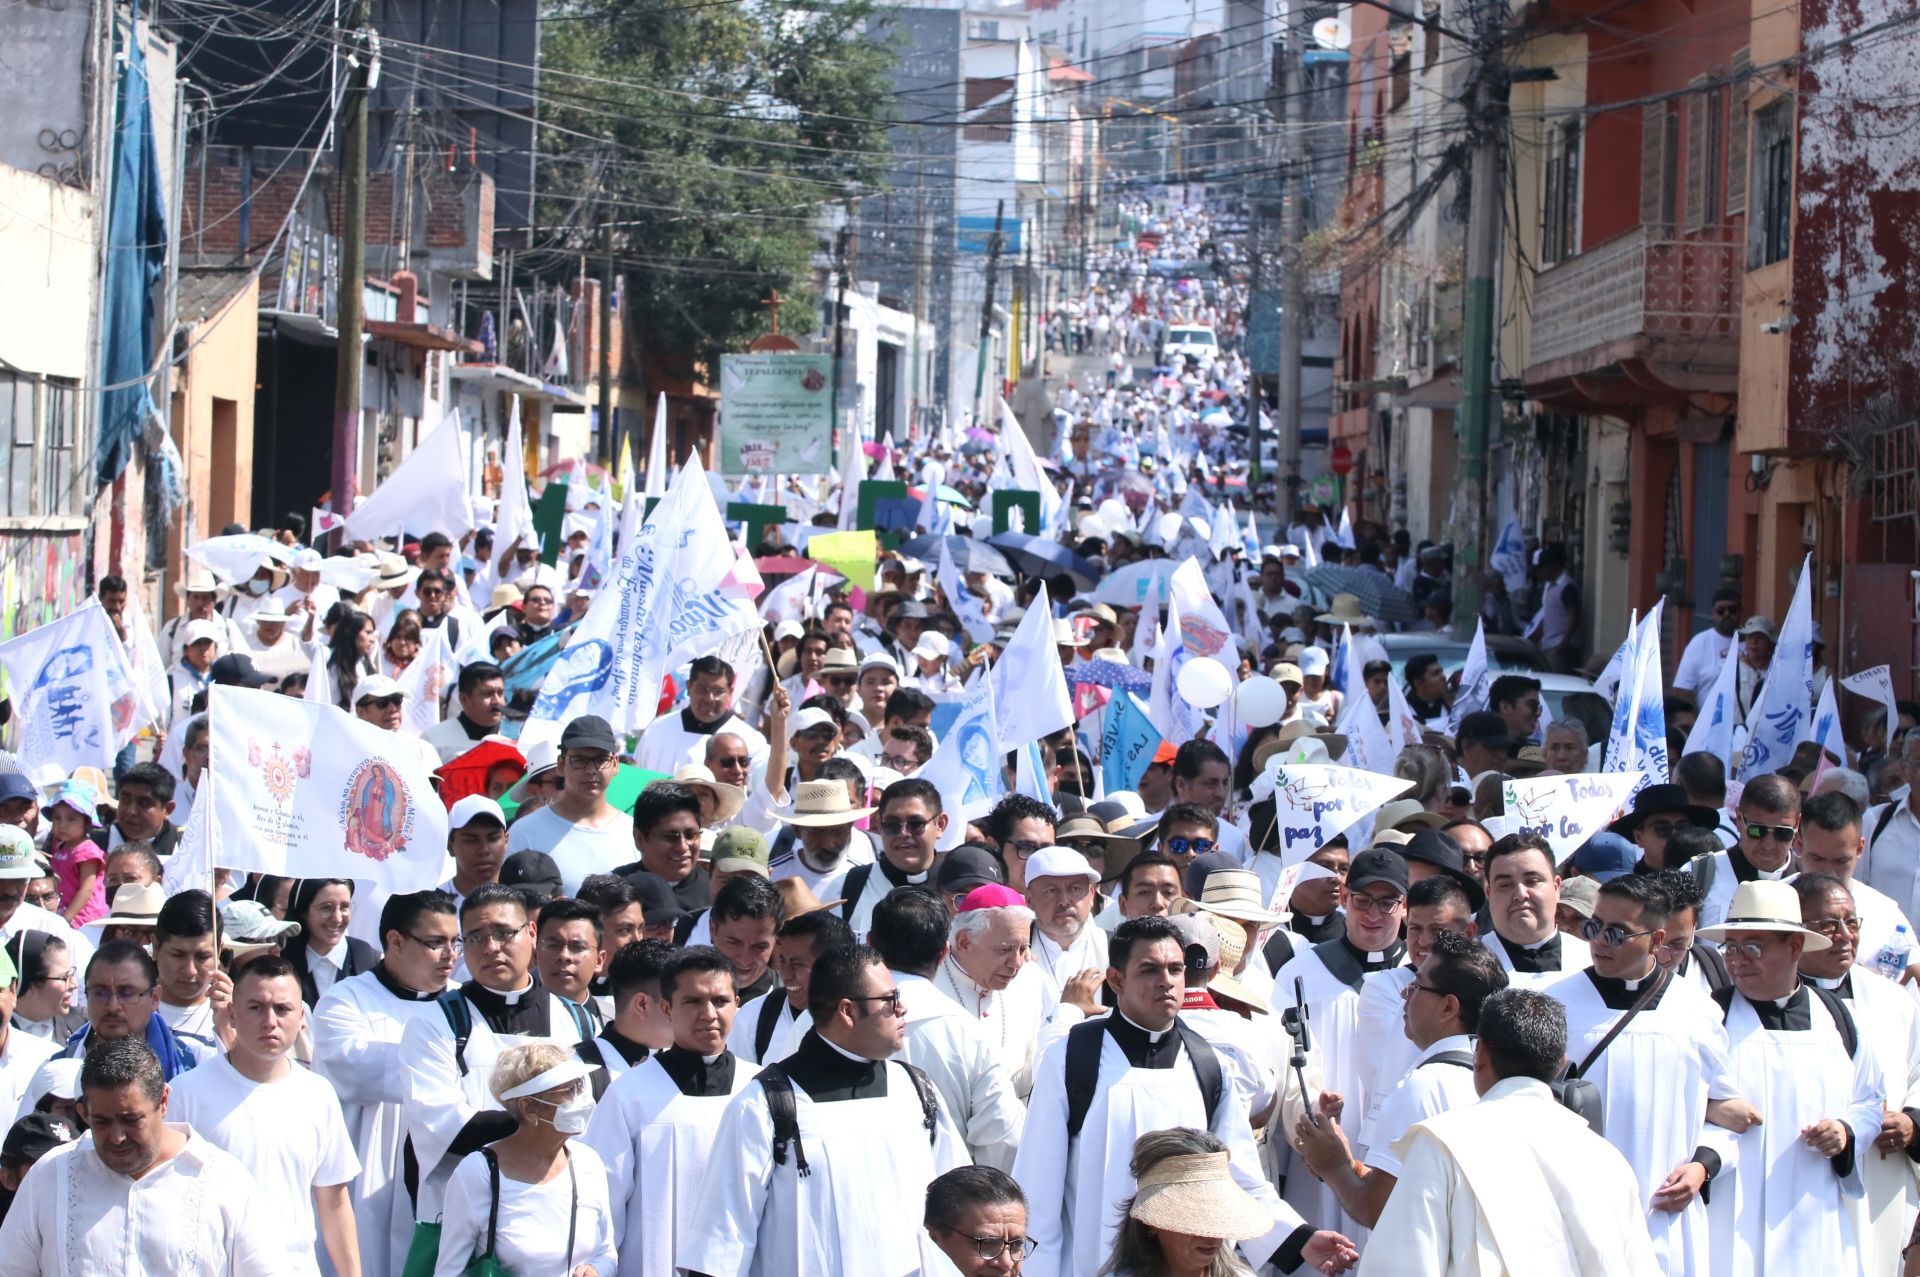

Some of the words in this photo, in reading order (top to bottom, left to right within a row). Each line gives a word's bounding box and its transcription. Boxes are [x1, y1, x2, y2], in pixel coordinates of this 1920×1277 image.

[1565, 777, 1614, 802] Todos
[1313, 800, 1346, 822] por
[1284, 825, 1324, 849] paz
[1560, 816, 1583, 838] la
